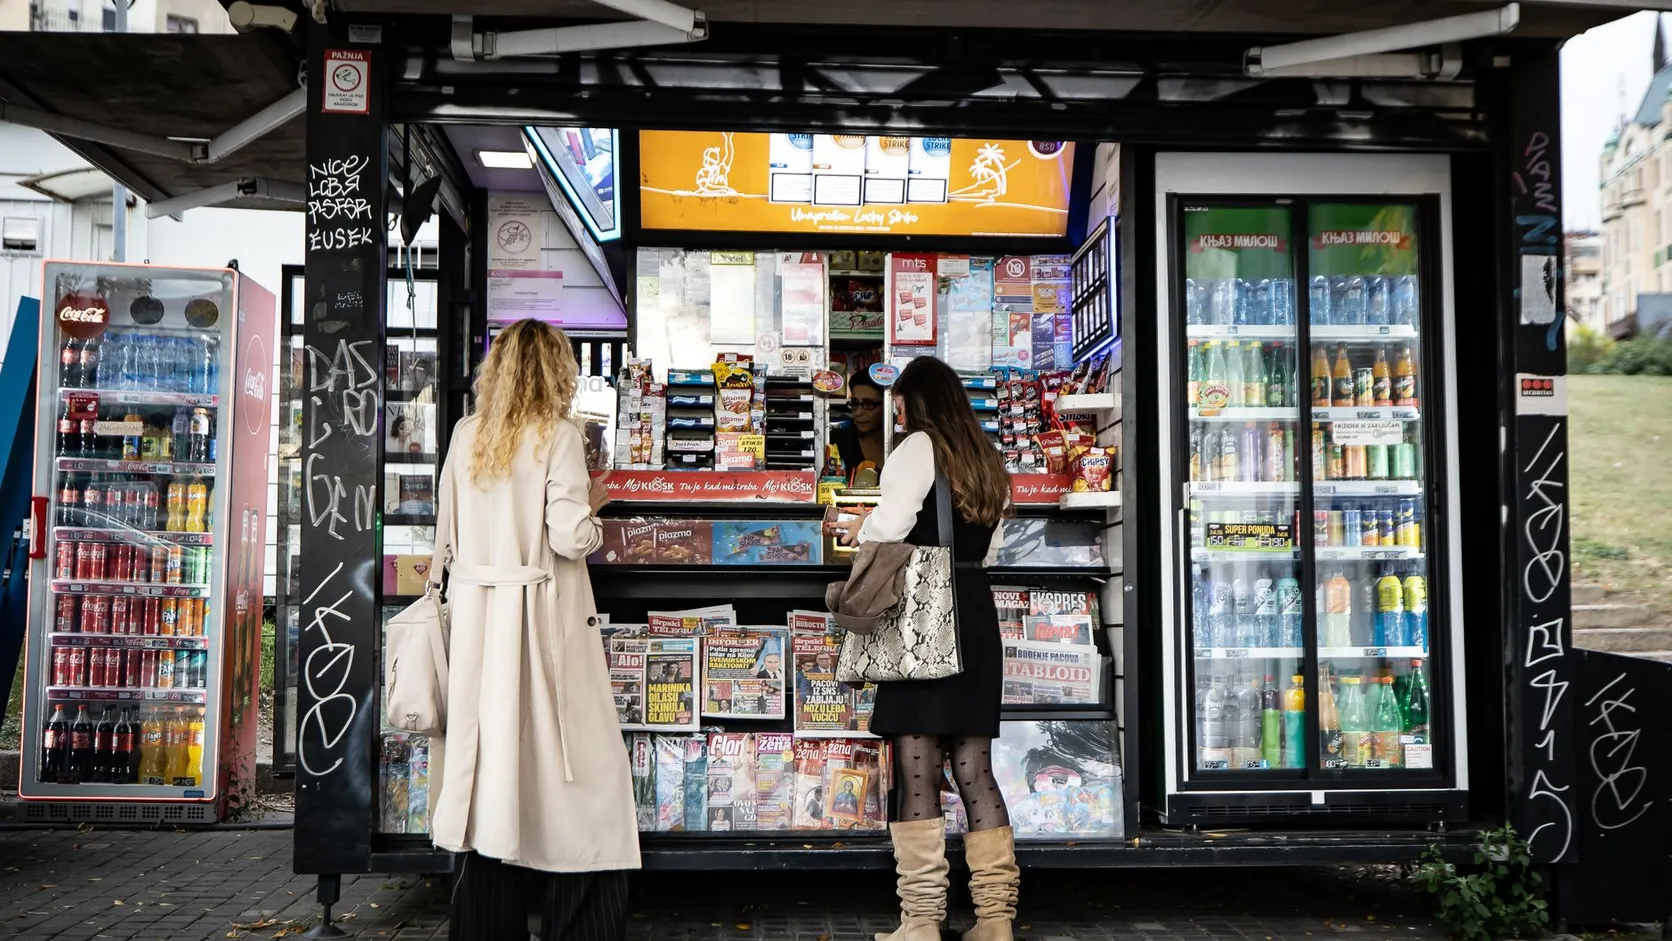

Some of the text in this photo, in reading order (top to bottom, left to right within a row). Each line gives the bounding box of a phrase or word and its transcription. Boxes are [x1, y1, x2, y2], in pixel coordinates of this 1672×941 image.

[331, 51, 363, 60] PAŽNJA
[1039, 142, 1056, 152] RSD
[853, 208, 885, 227] Lucky
[887, 208, 919, 225] Strike
[308, 227, 373, 251] EUSEK
[1200, 234, 1279, 247] КЊАЗ МИЛОШ
[1321, 231, 1401, 244] КЊАЗ МИЛОШ
[902, 257, 927, 268] mts
[720, 454, 753, 465] plazma
[623, 478, 641, 492] Moj
[680, 483, 692, 491] Tu
[691, 483, 702, 494] je
[704, 481, 722, 491] kad
[723, 481, 735, 491] mi
[735, 480, 759, 491] treba
[762, 480, 781, 493] Moj
[821, 486, 830, 494] 89
[1016, 484, 1072, 495] Tu je kad mi
[658, 527, 692, 542] plazma
[1225, 524, 1275, 534] SUPER PONUDA
[739, 537, 762, 549] Sugar
[1210, 535, 1224, 545] 150
[767, 551, 790, 560] Sugar
[994, 592, 1021, 600] NOVI
[1029, 591, 1087, 611] EKSPRES
[795, 620, 825, 629] НОВОСТИ
[1050, 651, 1079, 663] PACOVA
[1008, 661, 1091, 681] TABLOID
[648, 683, 691, 692] MARINIKA
[811, 680, 838, 688] PACOVI
[813, 687, 837, 696] IZ SNS
[806, 695, 844, 704] ZABIJAJU
[648, 702, 685, 712] SKINULA
[648, 711, 676, 723] GLAVU
[827, 739, 851, 755] žena
